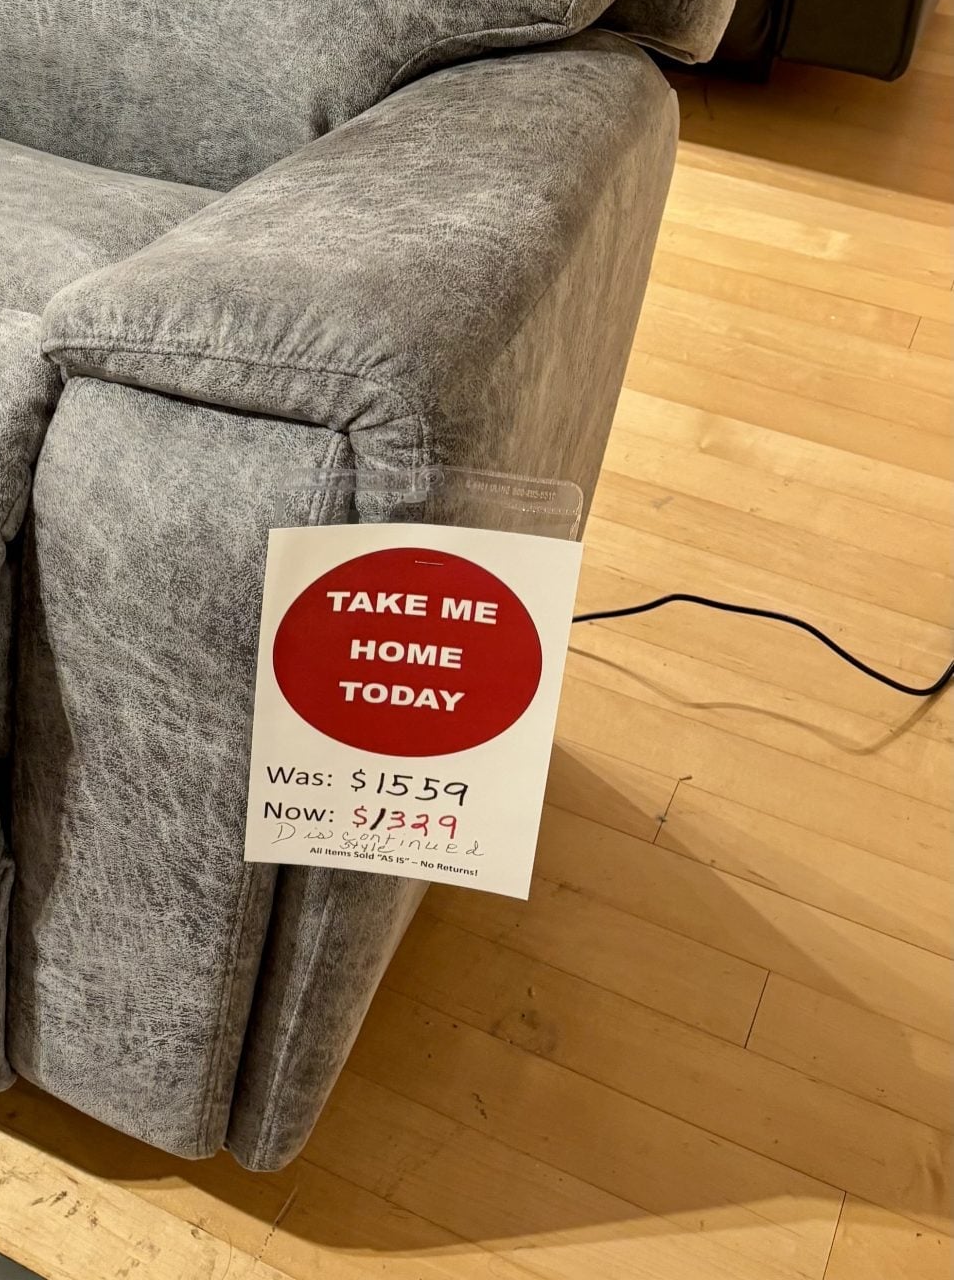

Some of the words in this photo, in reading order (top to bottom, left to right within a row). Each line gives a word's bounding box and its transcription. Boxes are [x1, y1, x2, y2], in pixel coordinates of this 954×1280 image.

[326, 591, 428, 616] TAKE
[440, 597, 498, 624] ME
[349, 639, 463, 669] HOME
[339, 681, 465, 712] TODAY
[266, 766, 333, 787] Was:
[350, 769, 469, 806] $1559
[263, 801, 335, 823] Now:
[352, 805, 458, 840] $1329
[310, 847, 323, 856] All
[324, 847, 352, 858] Items
[353, 851, 376, 861] Sold
[420, 860, 436, 869] No
[437, 864, 479, 877] Returns!
